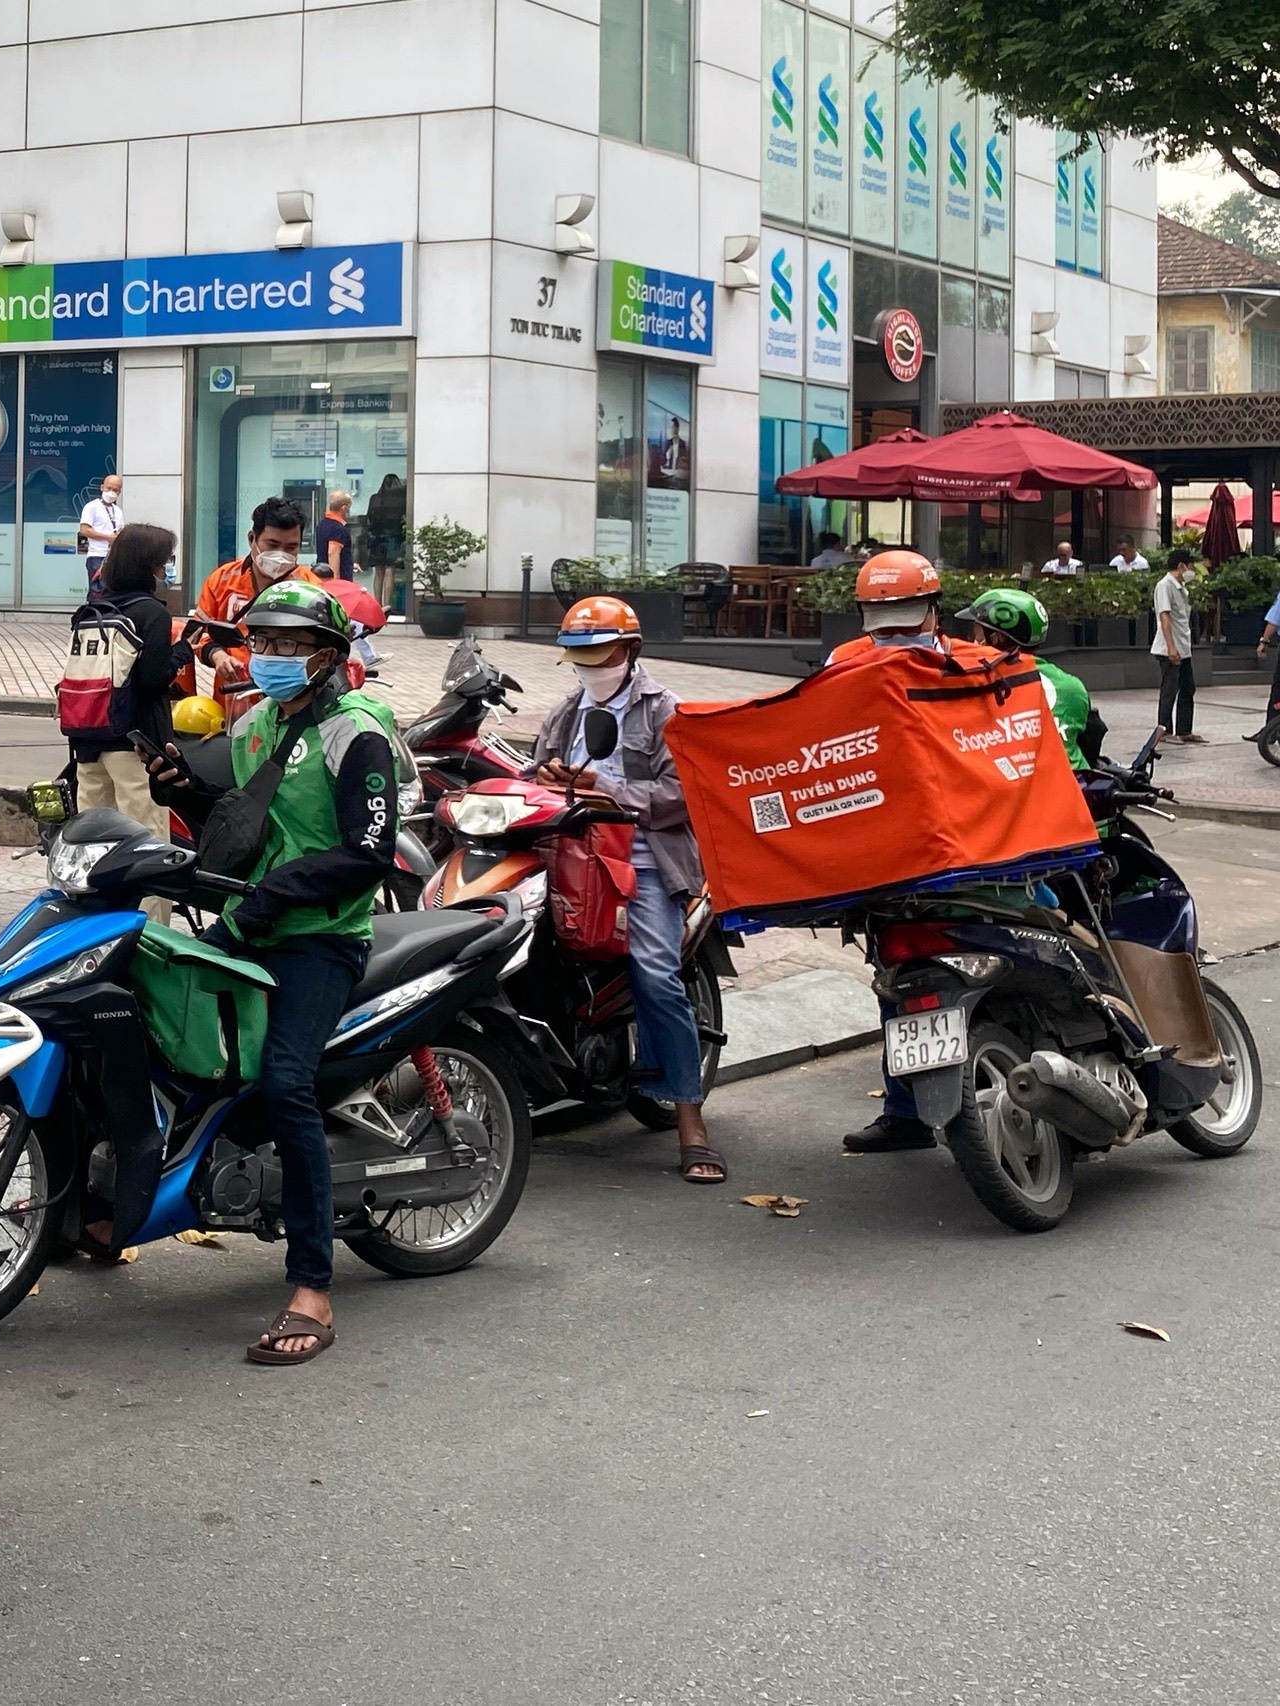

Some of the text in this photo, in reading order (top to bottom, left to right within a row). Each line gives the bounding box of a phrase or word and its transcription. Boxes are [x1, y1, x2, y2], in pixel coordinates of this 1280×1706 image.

[122, 271, 312, 316] Chartered
[537, 276, 558, 308] 37
[626, 275, 686, 310] Standard
[510, 317, 529, 334] TON
[531, 321, 550, 338] DUC
[619, 304, 685, 339] Chartered
[887, 314, 921, 346] HIGHLANDS
[768, 328, 796, 343] Standard
[815, 336, 841, 352] Standard
[766, 343, 796, 359] Chartered
[812, 351, 841, 367] Chartered
[891, 358, 917, 378] COFFEE
[320, 398, 393, 409] Express Banking
[54, 413, 69, 422] hoa
[918, 475, 975, 486] HIGHLANDS
[727, 734, 880, 787] Shopee XPRESS
[840, 799, 853, 809] QR
[93, 1010, 132, 1020] HONDA
[898, 1012, 950, 1043] 59-K1
[893, 1036, 961, 1071] 660.22
